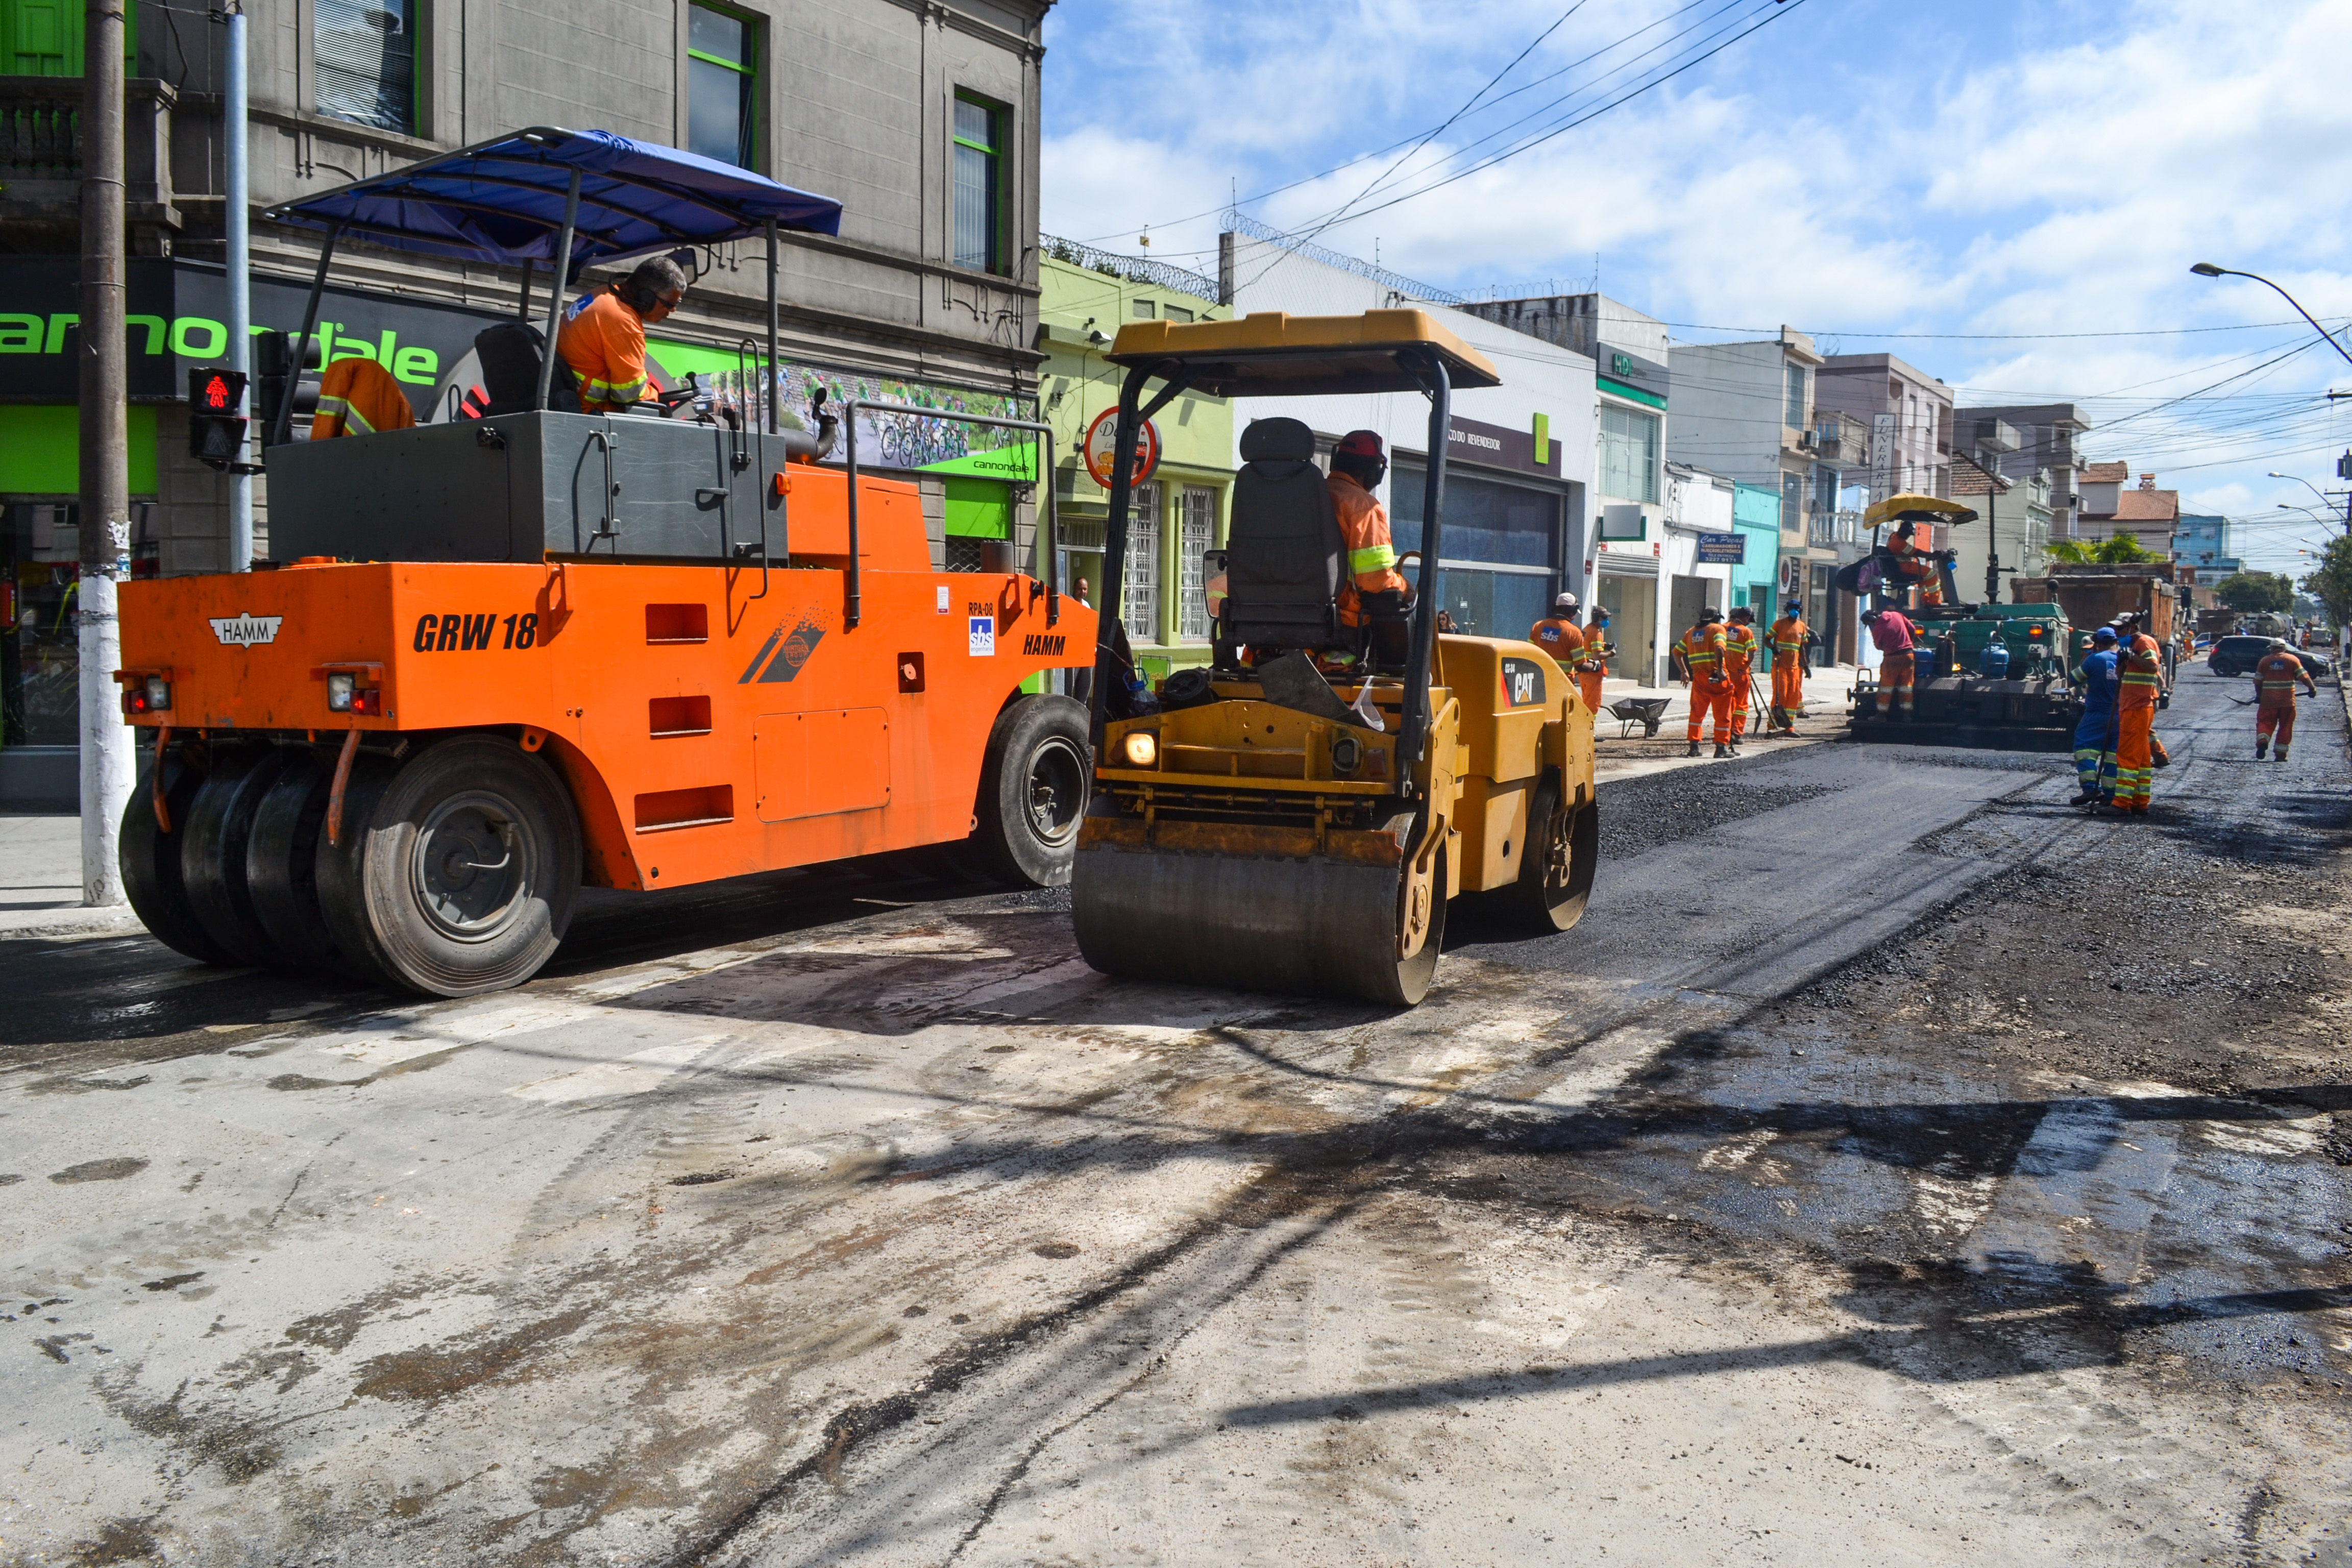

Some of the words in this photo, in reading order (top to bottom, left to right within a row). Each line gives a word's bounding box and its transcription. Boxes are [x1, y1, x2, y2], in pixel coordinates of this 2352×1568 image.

[1457, 431, 1465, 443] DO
[1468, 433, 1501, 451] REVENDEDOR
[974, 461, 1029, 473] cannondale
[1700, 535, 1716, 544] Car
[1720, 535, 1743, 544] Peças
[968, 602, 993, 617] RPA-08
[223, 621, 269, 641] HAMM
[413, 613, 497, 652] GRW
[503, 613, 538, 650] 18
[971, 625, 992, 646] sbs
[1540, 630, 1559, 642] sbs
[1692, 633, 1704, 643] sbs
[1023, 634, 1066, 656] HAMM
[1515, 673, 1534, 703] CAT
